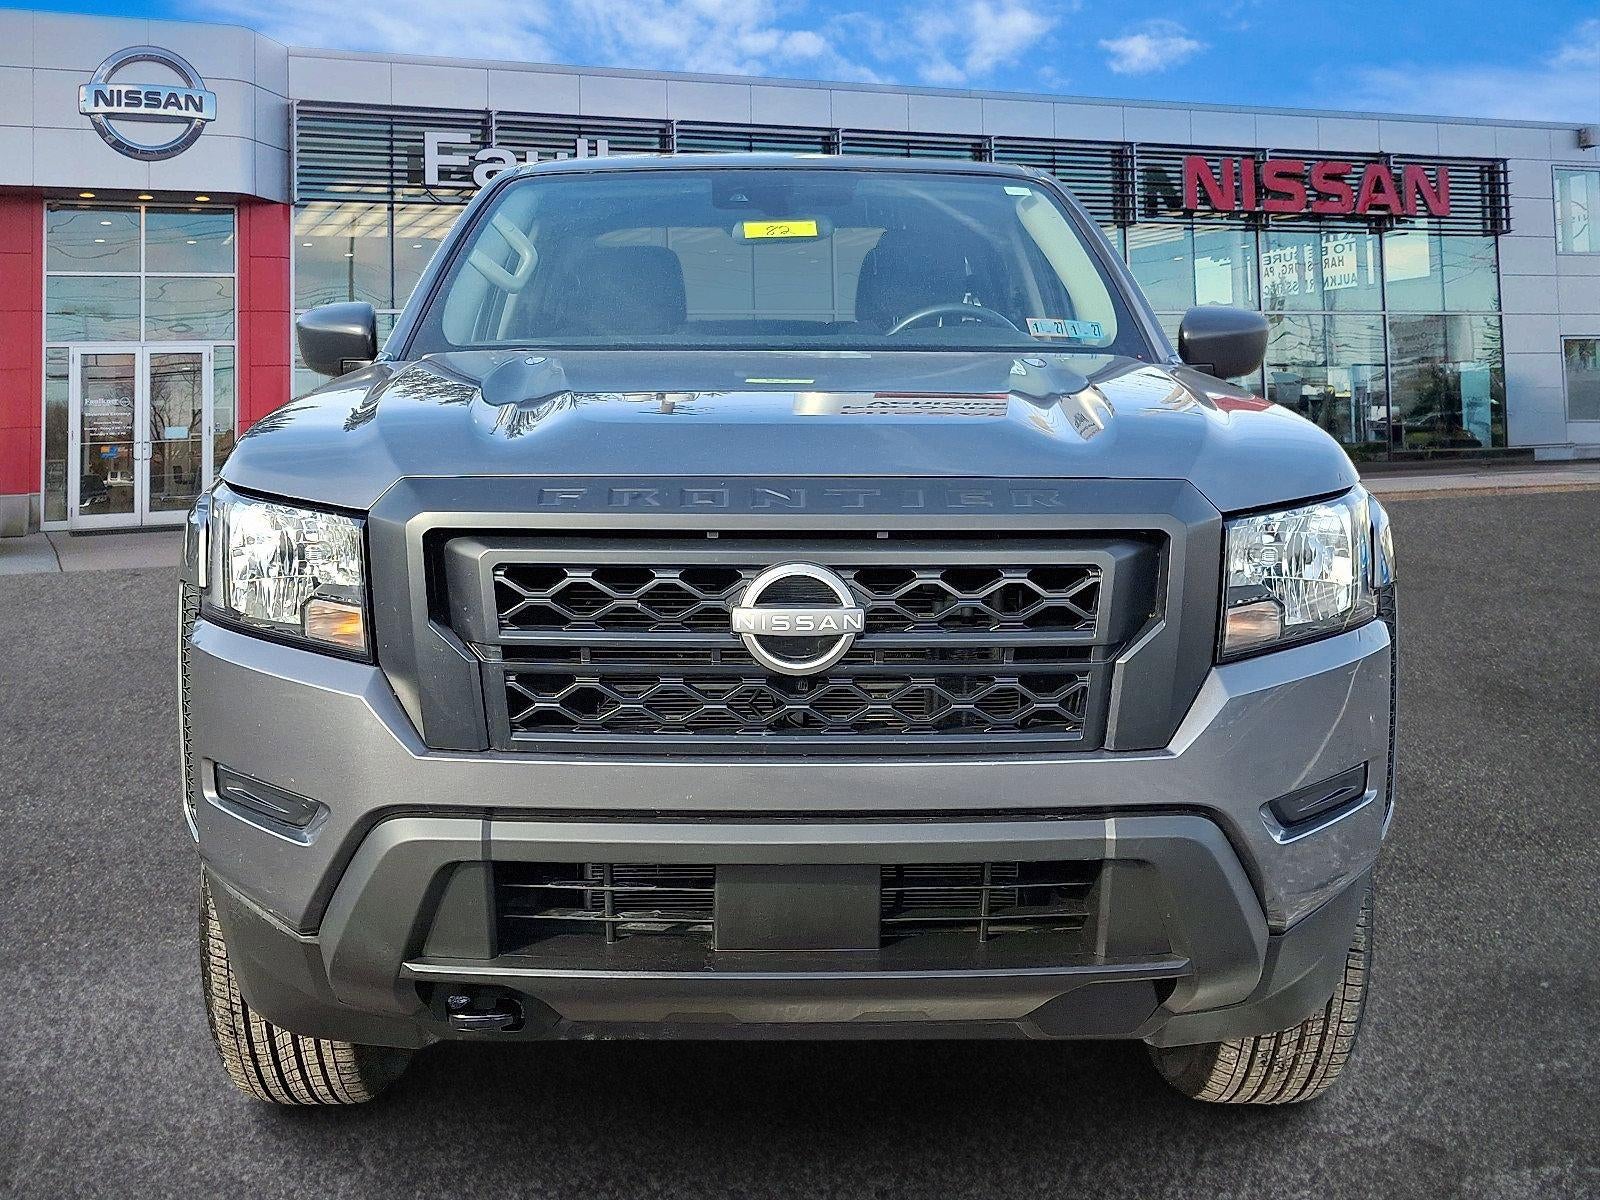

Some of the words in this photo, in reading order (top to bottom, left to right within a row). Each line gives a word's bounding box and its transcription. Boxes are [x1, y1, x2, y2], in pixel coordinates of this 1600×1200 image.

[93, 89, 204, 113] NISSAN
[1182, 154, 1451, 217] NISSAN
[537, 487, 1064, 508] FRONTIER
[735, 612, 862, 632] NISSAN
